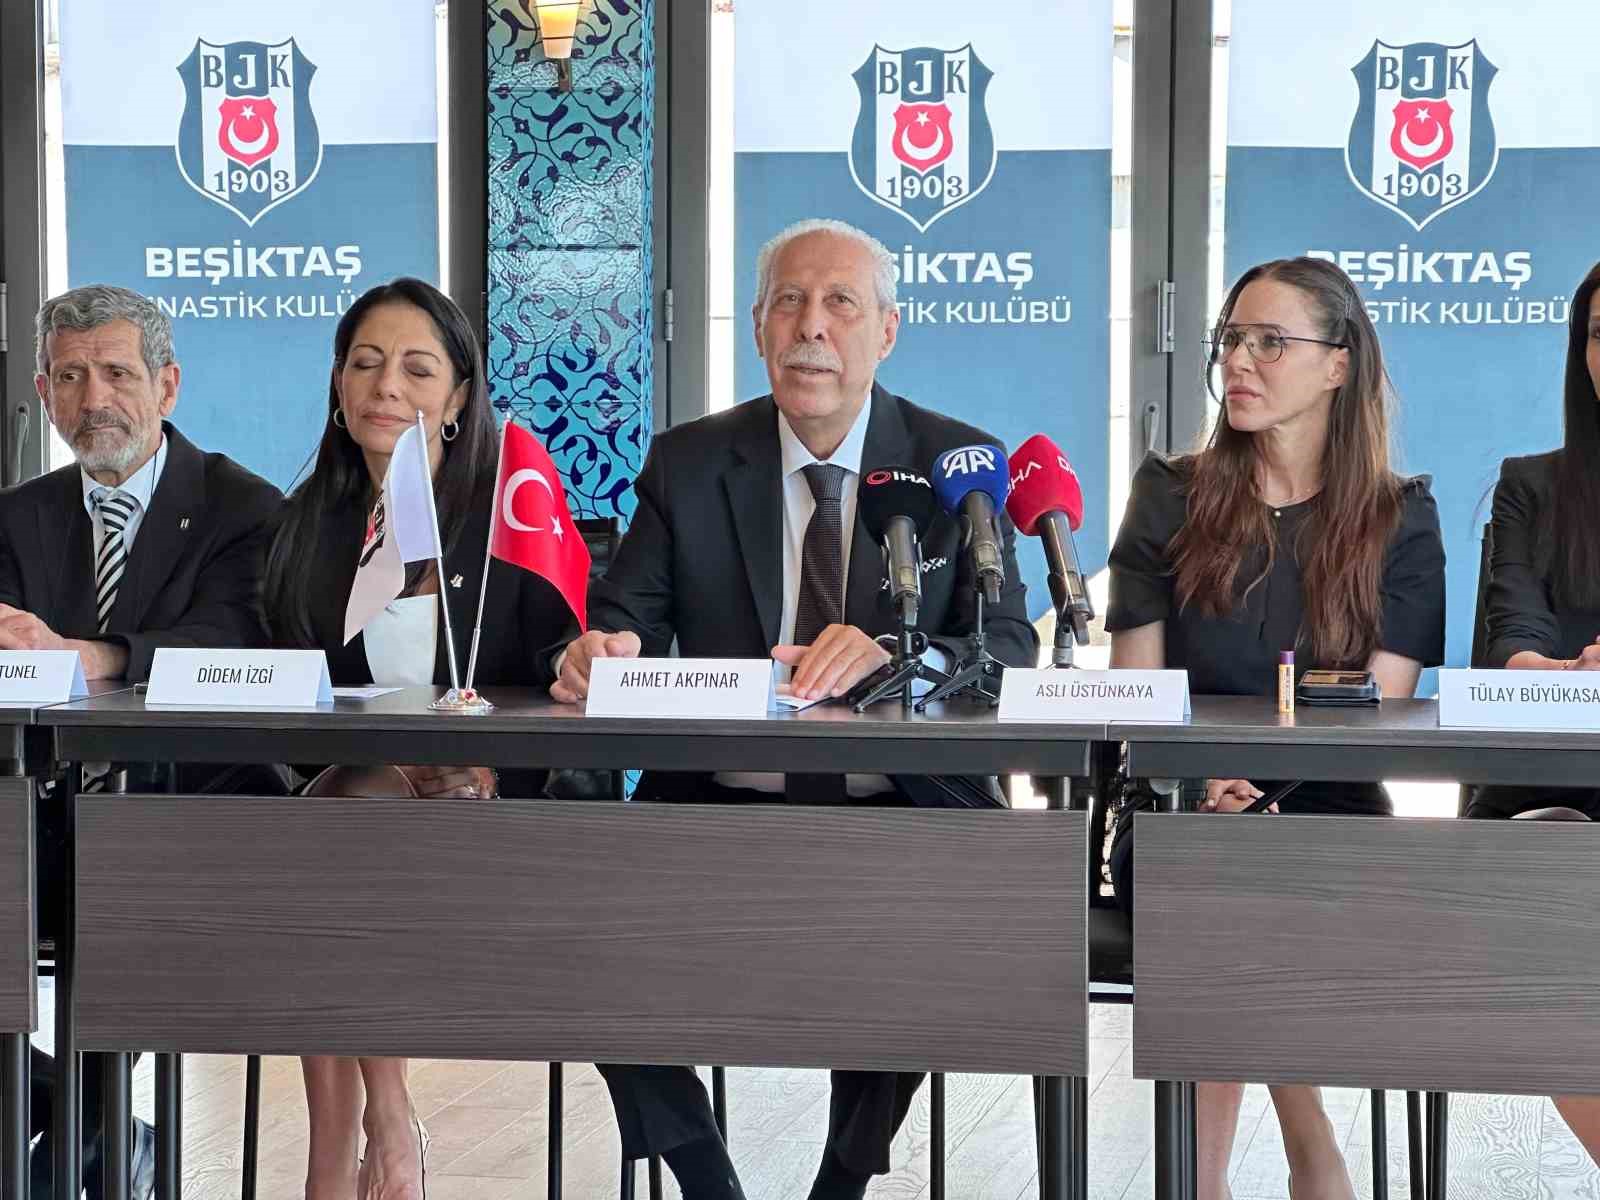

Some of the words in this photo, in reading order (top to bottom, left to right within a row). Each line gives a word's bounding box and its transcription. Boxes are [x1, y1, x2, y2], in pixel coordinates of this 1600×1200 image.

[203, 54, 292, 89] BJK
[878, 60, 967, 95] BJK
[1376, 55, 1471, 91] BJK
[213, 169, 290, 193] 1903
[886, 175, 963, 199] 1903
[1382, 173, 1463, 197] 1903
[145, 239, 362, 285] BEŞİKTAŞ
[889, 244, 1034, 290] İKTAŞ
[146, 291, 270, 318] NASTİK
[276, 289, 358, 318] KULÜ
[945, 296, 1072, 323] KULÜBÜ
[1439, 295, 1569, 324] KULÜBÜ
[943, 448, 996, 479] AA
[0, 665, 38, 679] TUNEL
[197, 664, 241, 683] DİDEM
[246, 664, 274, 684] İZGİ
[620, 672, 671, 688] AHMET
[675, 672, 739, 689] AKPINAR
[1036, 684, 1066, 698] ASLI
[1070, 680, 1154, 699] ÜSTÜNKAYA
[1469, 682, 1514, 702] TÜLAY
